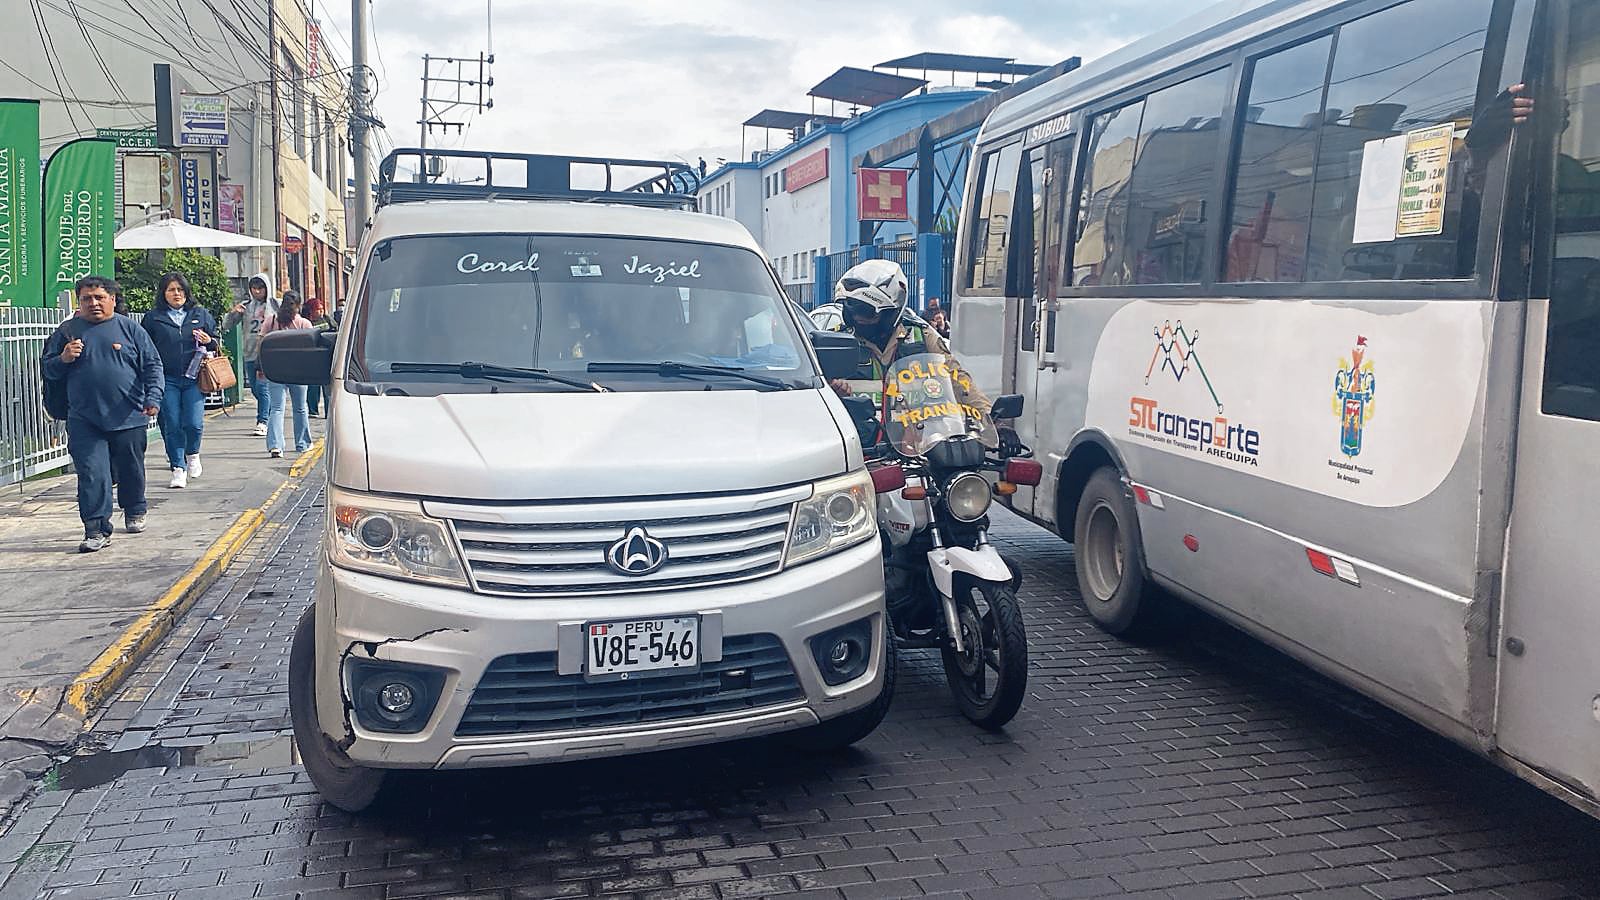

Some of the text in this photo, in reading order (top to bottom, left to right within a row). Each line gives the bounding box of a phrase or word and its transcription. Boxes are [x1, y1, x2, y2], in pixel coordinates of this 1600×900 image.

[1031, 113, 1072, 142] SUBIDA
[119, 138, 154, 147] C.C.E.R.
[56, 190, 76, 282] PARQUE DEL
[74, 190, 91, 282] RECUERDO
[456, 252, 540, 274] Coral
[623, 255, 702, 283] Jaziel
[898, 400, 982, 428] TRANSITO
[1206, 447, 1258, 467] AREQUIPA
[625, 621, 664, 634] PERU
[593, 630, 694, 668] V8E-546
